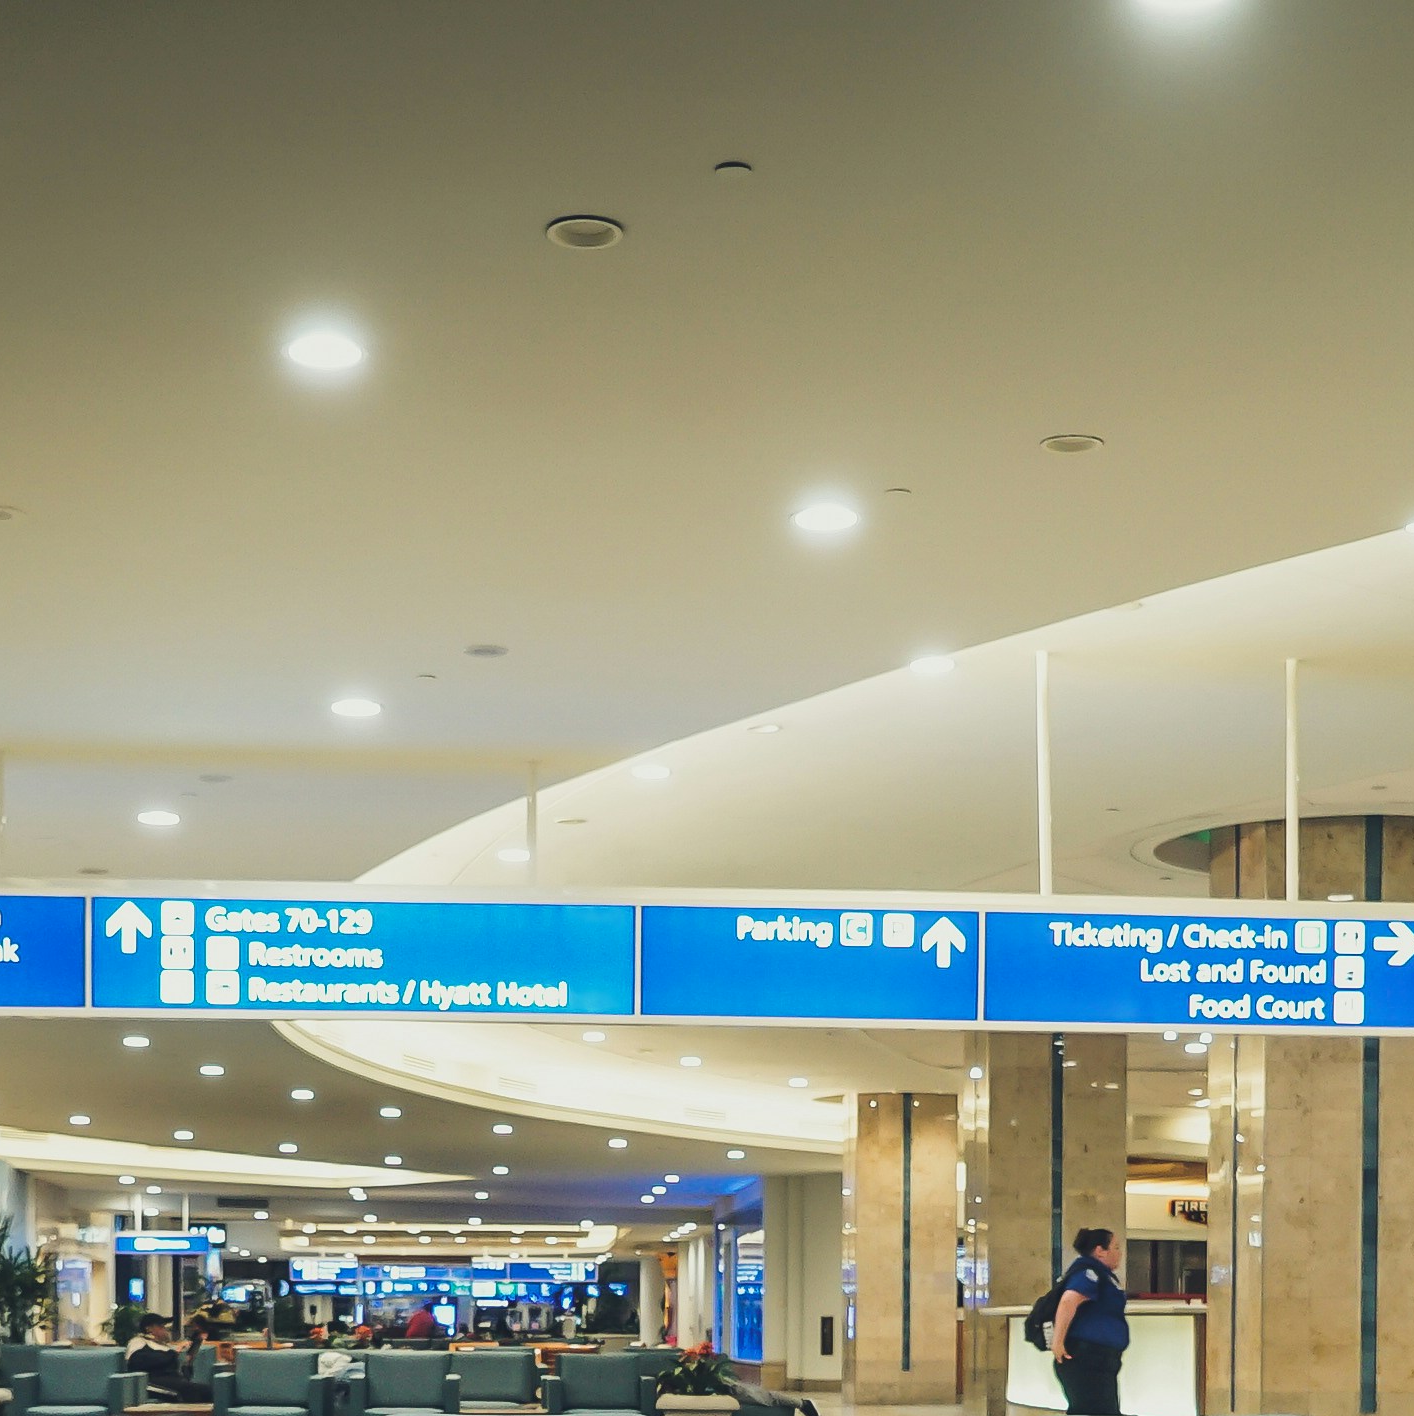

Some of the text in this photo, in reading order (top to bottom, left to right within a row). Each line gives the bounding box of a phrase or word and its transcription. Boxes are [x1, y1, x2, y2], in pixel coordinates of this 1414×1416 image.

[204, 905, 374, 935] Gates 70-129
[736, 915, 834, 948] Parking
[1048, 922, 1288, 952] Ticketing / Check-in
[248, 941, 383, 969] Restrooms
[1141, 958, 1327, 984] Lost and Found
[248, 977, 399, 1004] Restaurants
[420, 980, 492, 1010] Hyatt
[497, 981, 568, 1007] Hotel
[1189, 993, 1326, 1020] Food Court
